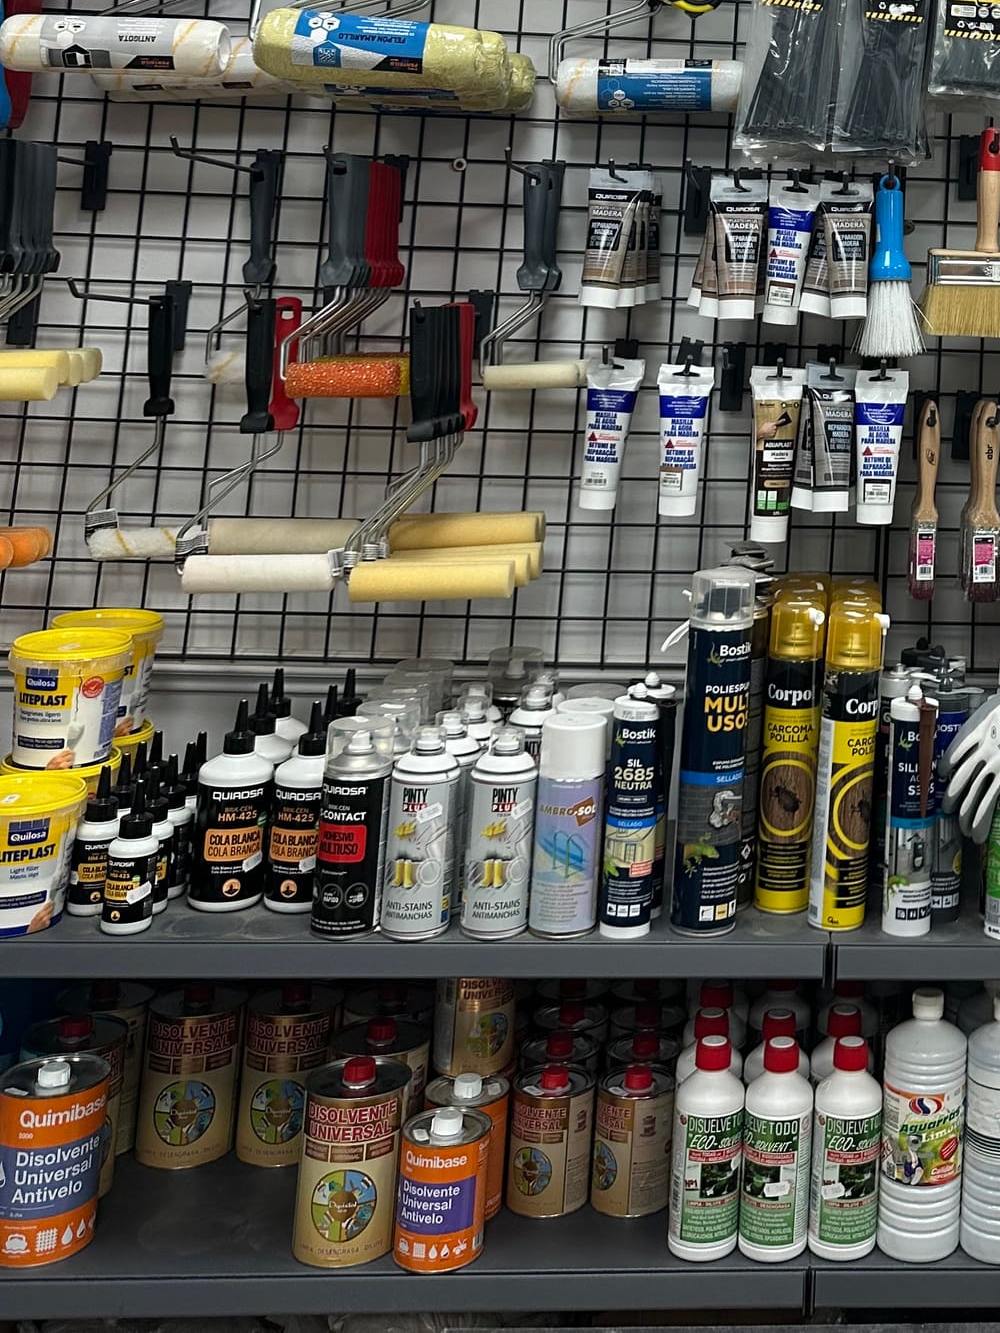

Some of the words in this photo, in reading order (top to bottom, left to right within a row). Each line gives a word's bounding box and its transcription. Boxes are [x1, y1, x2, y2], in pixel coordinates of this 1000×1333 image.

[118, 35, 156, 43] ANTIGOTA
[337, 32, 372, 42] AMARILLO
[592, 209, 622, 217] MADERA
[720, 643, 751, 656] Bostik
[27, 677, 56, 688] Quilosa
[706, 682, 750, 694] POLIESPU
[19, 695, 67, 706] LITEPLAST
[768, 684, 813, 706] Corpo
[622, 728, 656, 740] Bostik
[768, 723, 813, 733] CARCOMA
[770, 733, 809, 742] POLILLA
[627, 759, 642, 768] SIL
[614, 767, 654, 781] 2685
[614, 780, 653, 791] NEUTRA
[212, 788, 264, 802] QUIADSA
[276, 789, 321, 801] QUIADSA
[403, 788, 428, 802] PINTY
[492, 788, 518, 802] PINTY
[217, 809, 257, 822] HM-425
[278, 811, 314, 822] HM-425
[617, 820, 643, 828] SELLADO
[10, 830, 47, 842] Quilosa
[209, 833, 230, 846] COLA
[232, 830, 260, 844] BLANCA
[273, 833, 288, 844] COLA
[289, 832, 319, 845] BLANCA
[208, 845, 229, 857] COLA
[230, 841, 260, 857] BRANCA
[271, 845, 286, 857] COLA
[287, 845, 317, 857] BRANCA
[387, 901, 432, 910] ANTI-STAINS
[473, 900, 520, 910] ANTI-STAINS
[386, 911, 432, 920] ANTIMANCHAS
[472, 909, 520, 920] ANTIMANCHAS
[151, 1017, 235, 1038] DISOLVENTE
[151, 1035, 231, 1055] UNIVERSAL
[19, 1095, 108, 1129] Quimibase
[308, 1099, 398, 1120] DISOLVENTE
[309, 1121, 393, 1142] UNIVERSAL
[688, 1117, 731, 1134] DISUELVE
[769, 1121, 798, 1134] TODO
[827, 1117, 870, 1134] DISUELVE
[16, 1136, 101, 1167] Disolvente
[406, 1150, 467, 1168] Quimibase
[14, 1154, 93, 1186] Universal
[12, 1180, 82, 1204] Antivelo
[403, 1183, 460, 1197] Disolvente
[402, 1197, 452, 1211] Universal
[401, 1208, 443, 1225] Antivelo
